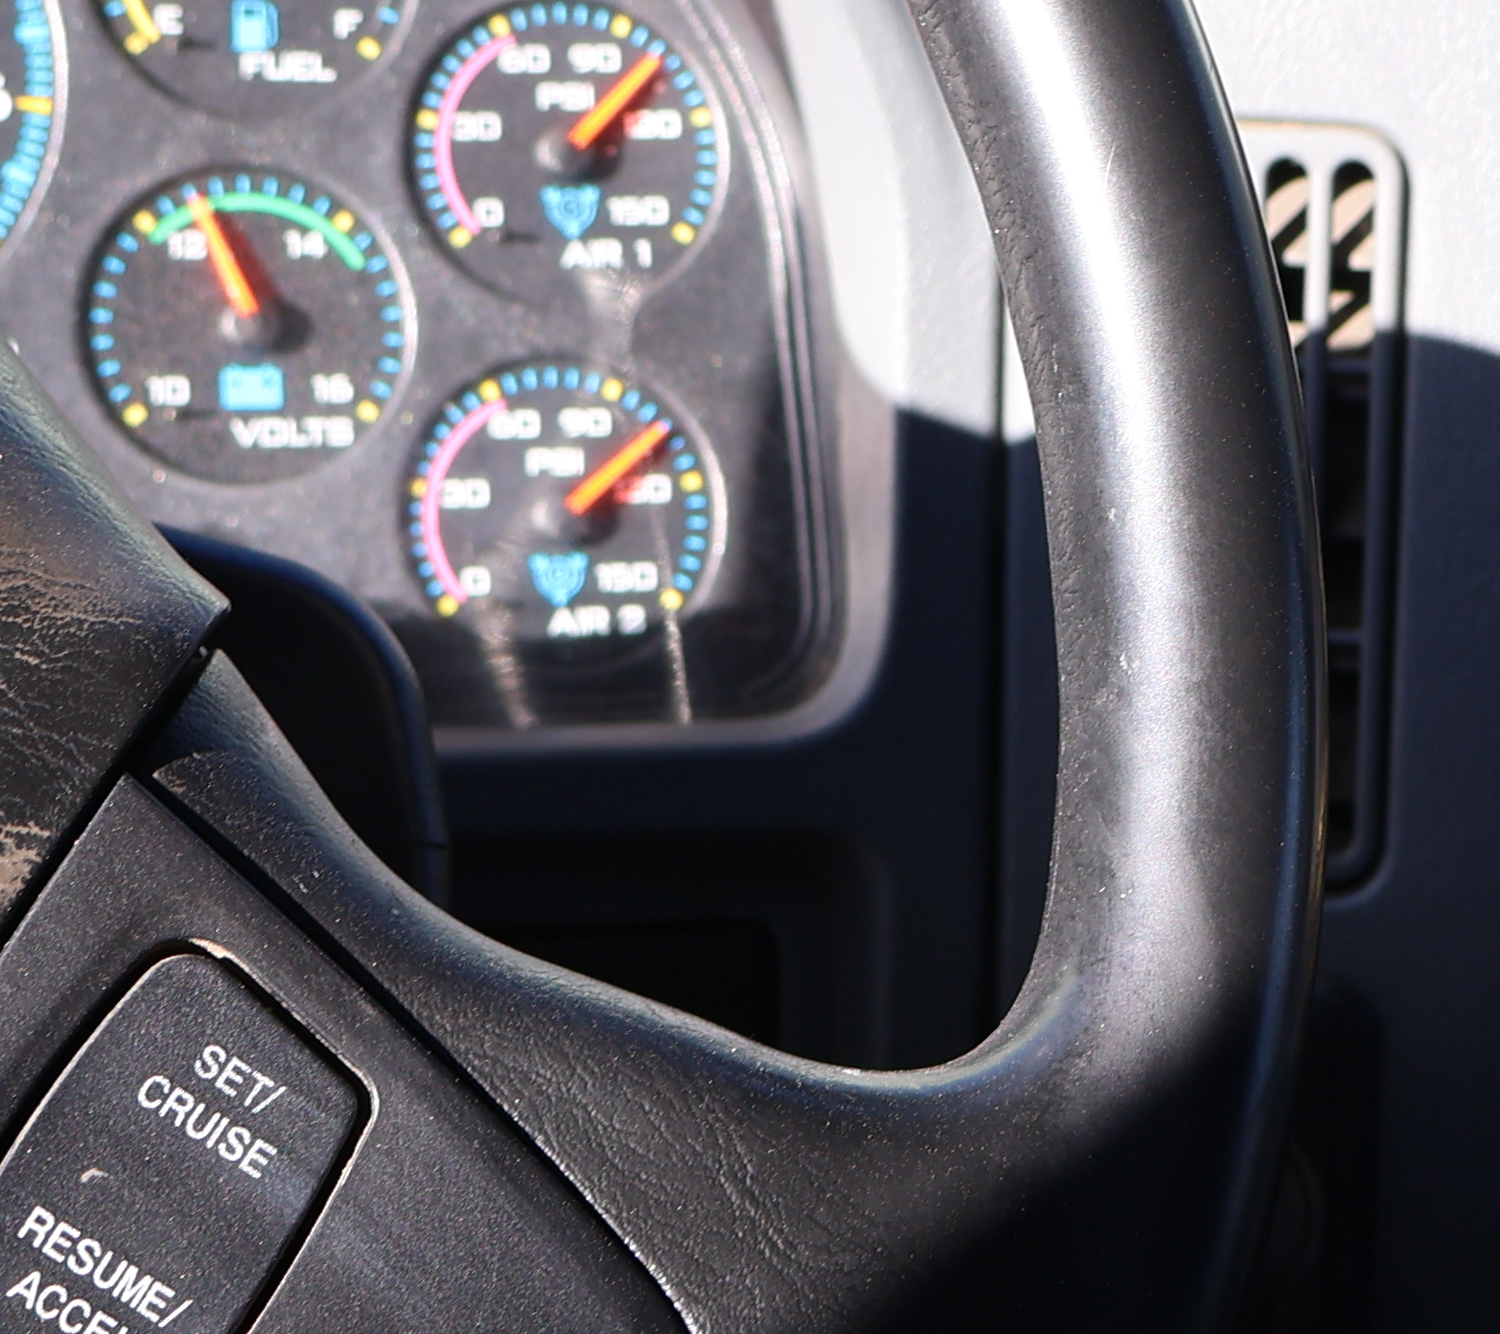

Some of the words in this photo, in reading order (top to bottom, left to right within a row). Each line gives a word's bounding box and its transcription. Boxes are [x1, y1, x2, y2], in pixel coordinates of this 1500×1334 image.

[153, 3, 183, 35] E
[333, 8, 363, 39] F
[238, 50, 337, 83] FUEL
[497, 43, 551, 74] 60
[568, 43, 622, 73] 90
[535, 81, 595, 111] PSI
[452, 110, 502, 142] 30
[606, 194, 670, 226] 150
[167, 229, 208, 260] 12
[283, 229, 328, 259] 14
[559, 238, 623, 269] AIR
[634, 238, 652, 268] 1
[146, 374, 190, 406] 10
[311, 373, 354, 404] 16
[230, 415, 354, 448] VOLTS
[487, 408, 541, 440] 60
[558, 407, 612, 438] 90
[525, 446, 584, 477] PSI
[439, 478, 491, 509] 30
[595, 561, 658, 592] 150
[547, 605, 611, 637] AIR
[618, 604, 647, 636] 2
[194, 1044, 288, 1114] SET/
[137, 1074, 278, 1179] CRUISE
[16, 1205, 194, 1328] RESUME/
